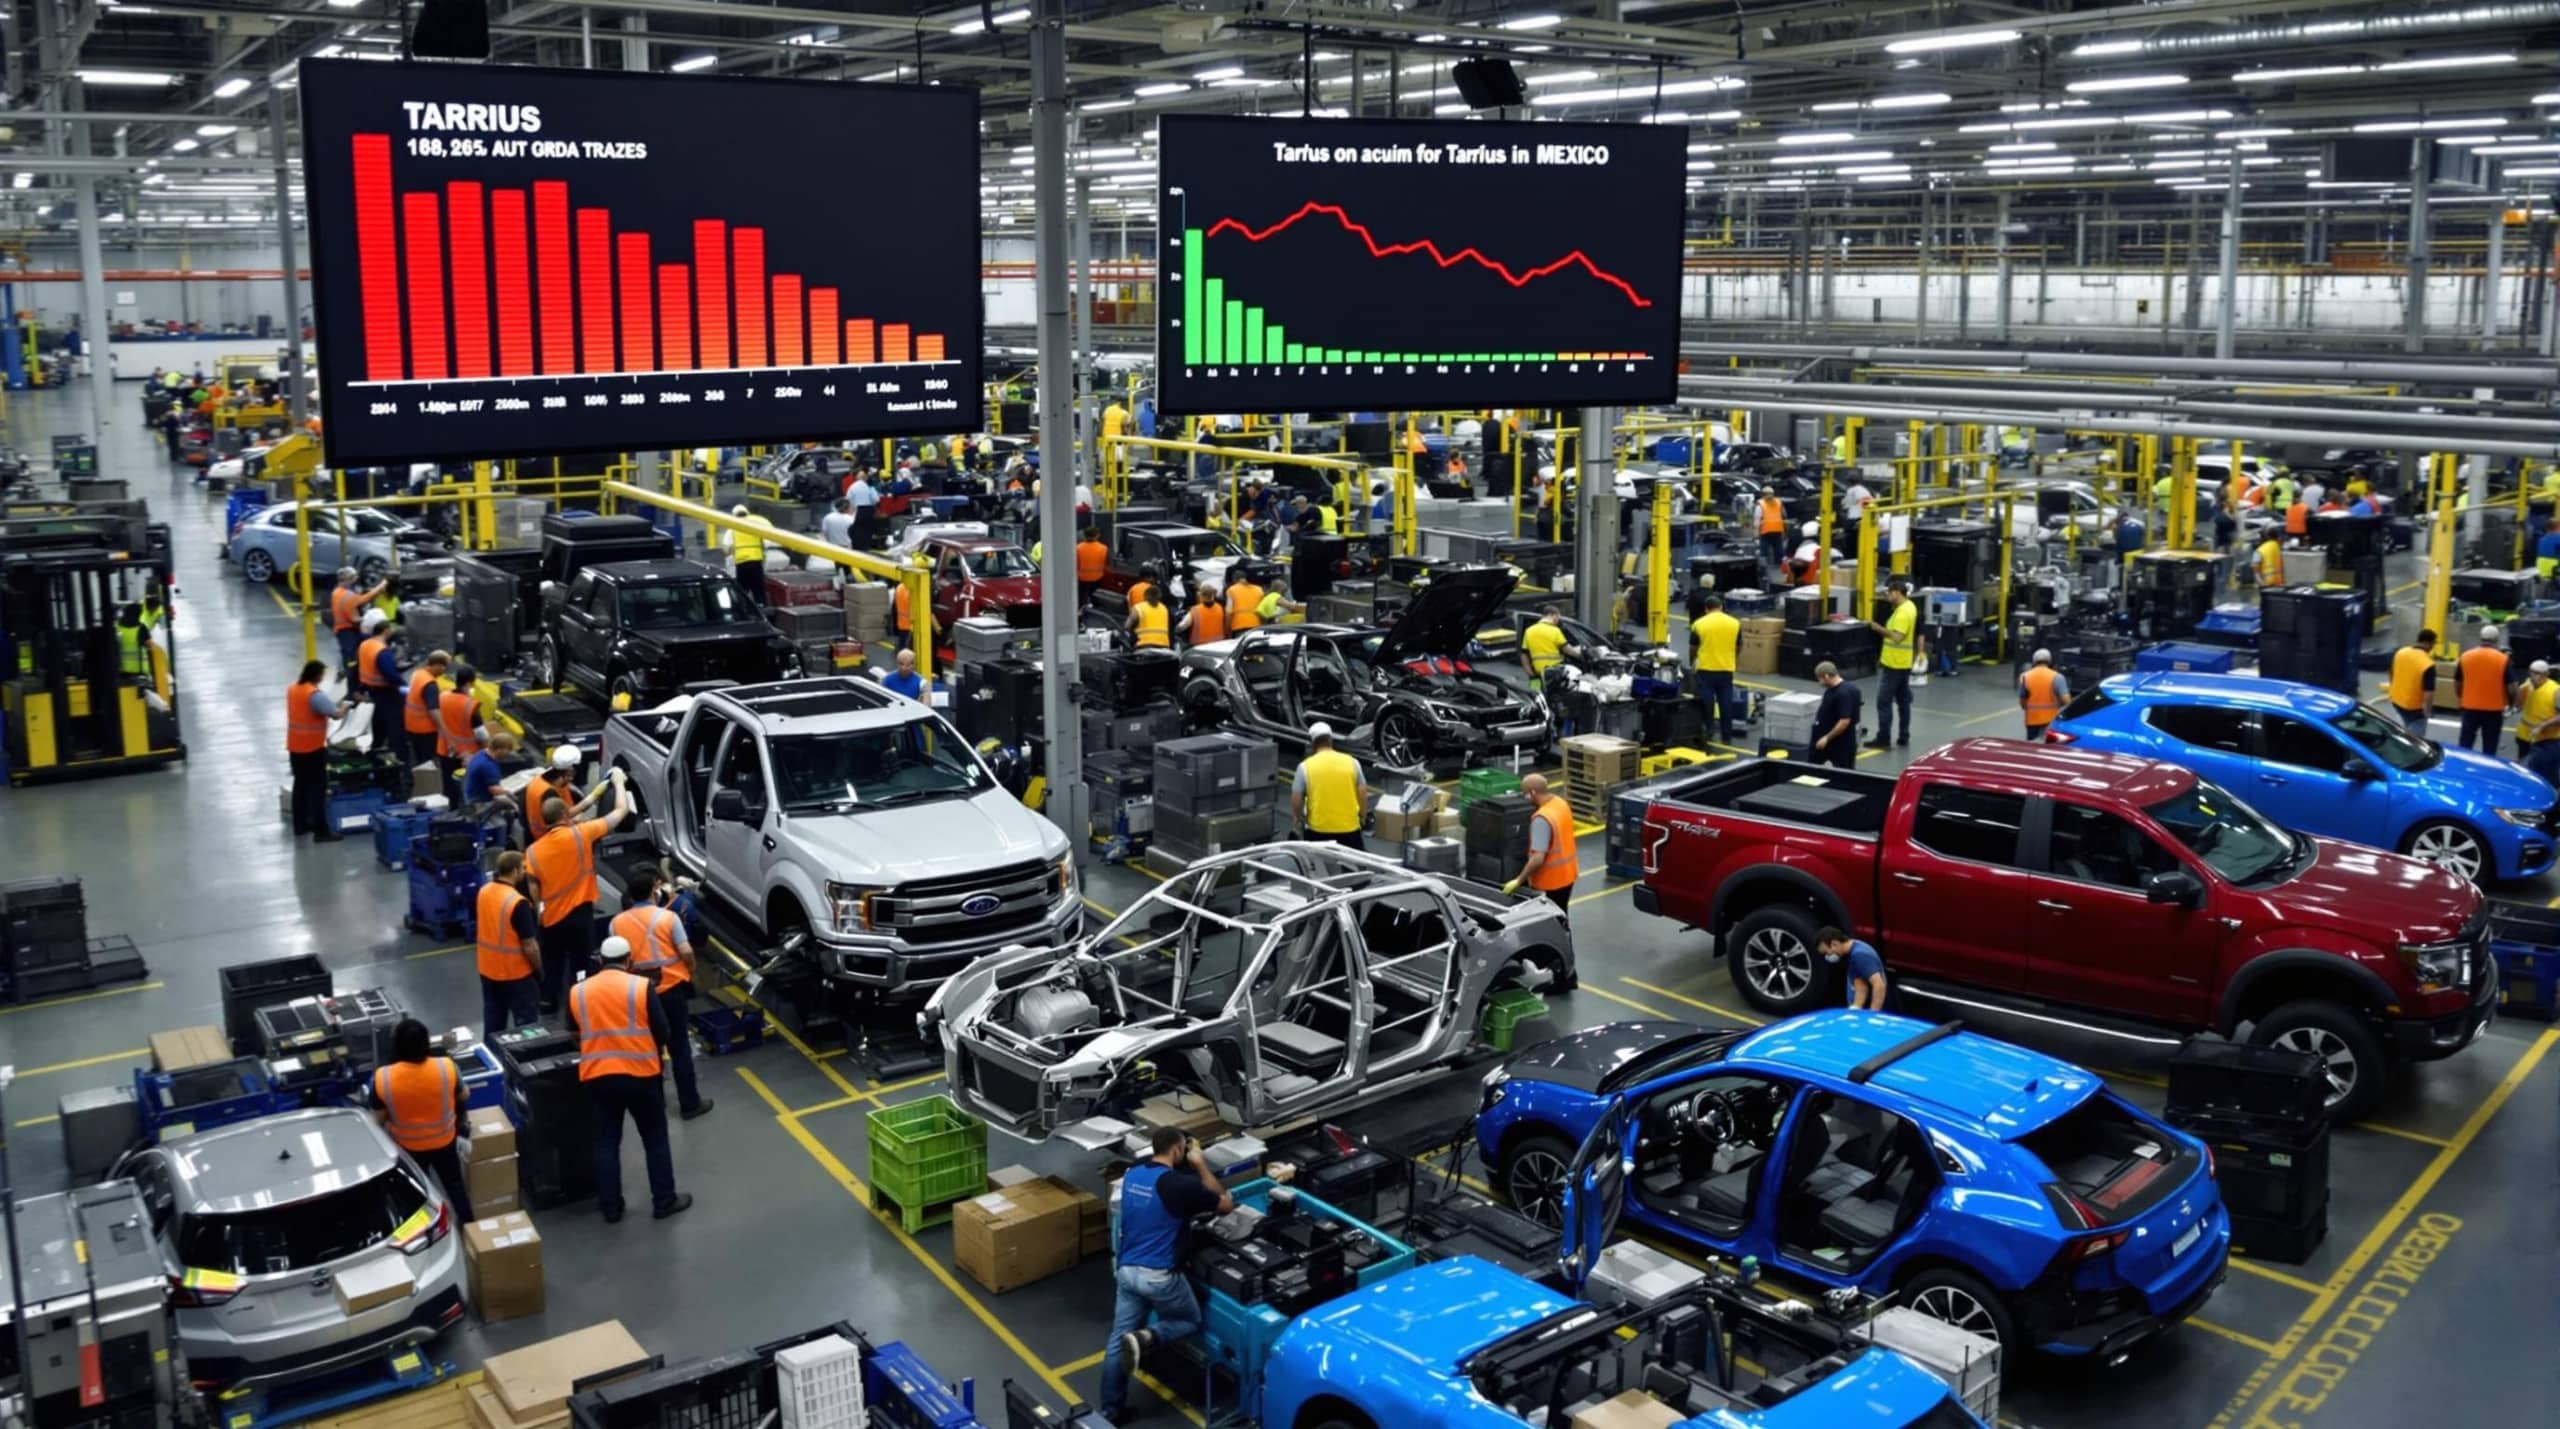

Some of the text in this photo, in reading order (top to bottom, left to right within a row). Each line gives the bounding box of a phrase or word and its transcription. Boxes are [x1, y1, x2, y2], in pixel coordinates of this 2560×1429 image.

[403, 102, 541, 133] TARRIUS
[492, 140, 529, 157] AUT
[582, 142, 647, 160] TRAZES
[1334, 147, 1357, 163] on
[1361, 143, 1413, 163] acuim
[1416, 143, 1443, 163] for
[1512, 145, 1530, 164] in
[1536, 144, 1610, 165] MEXICO
